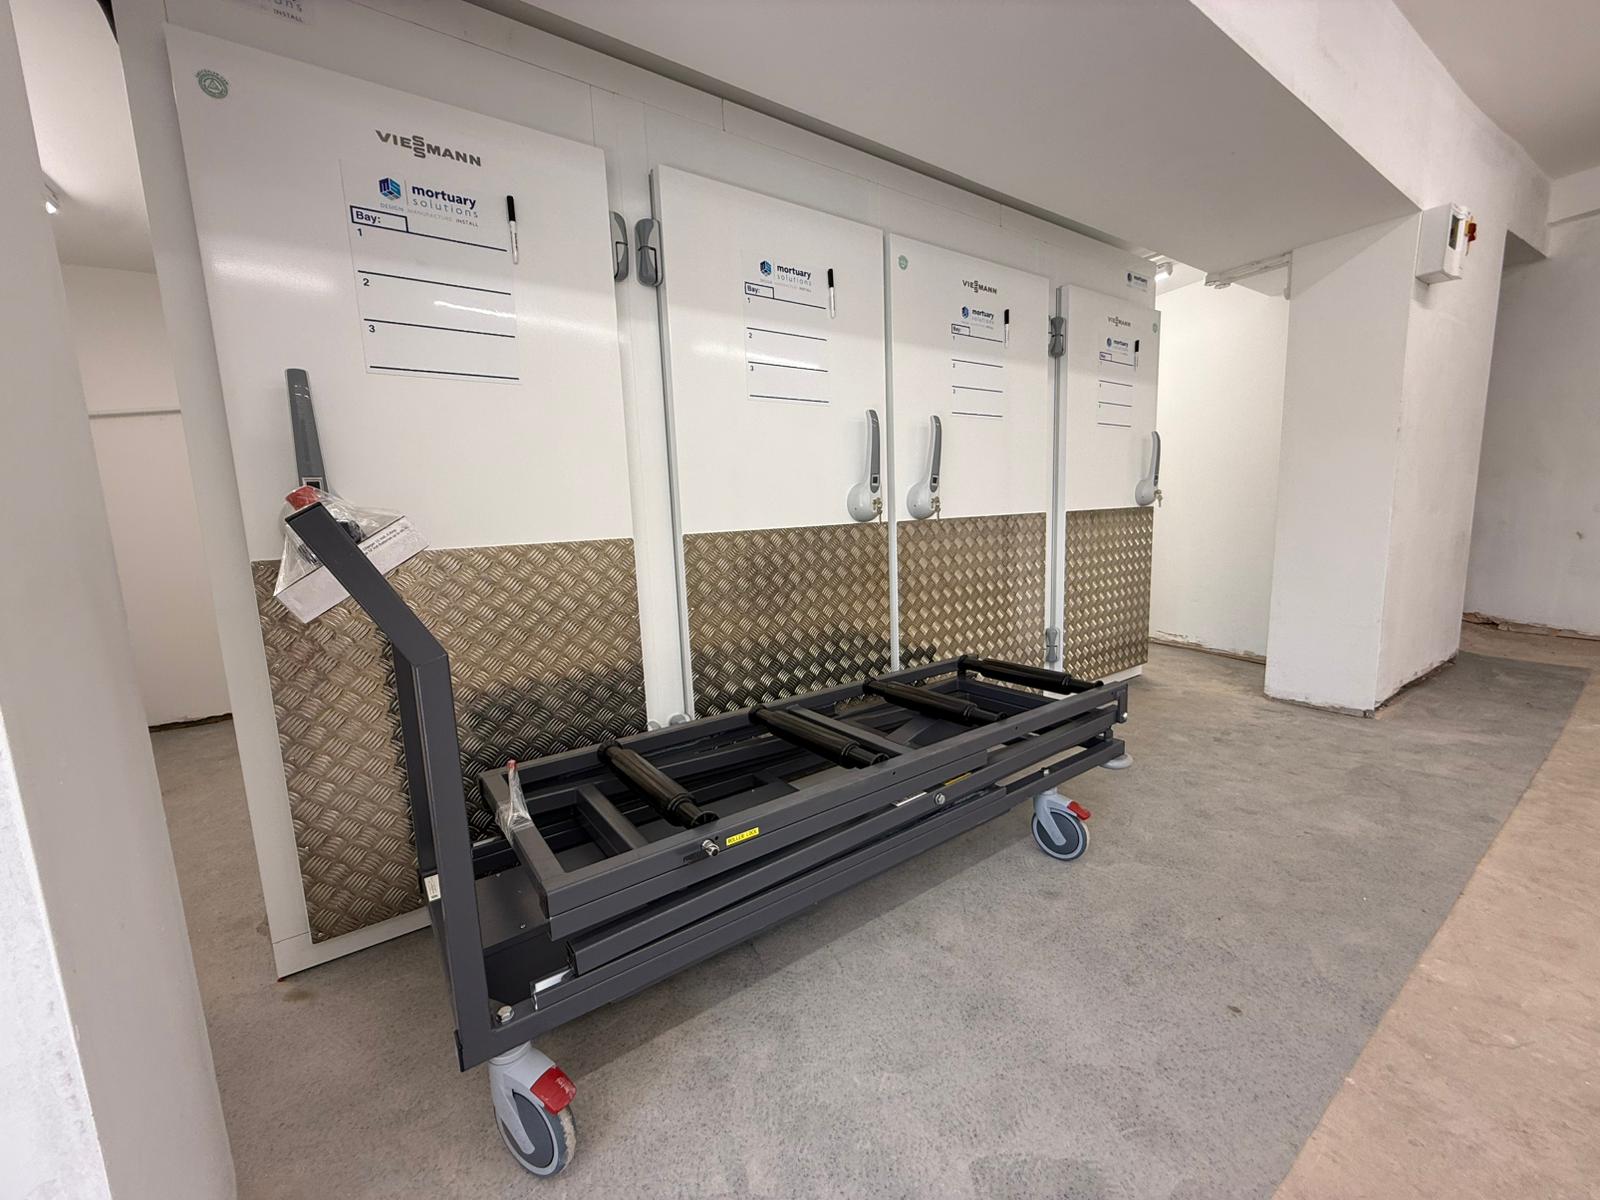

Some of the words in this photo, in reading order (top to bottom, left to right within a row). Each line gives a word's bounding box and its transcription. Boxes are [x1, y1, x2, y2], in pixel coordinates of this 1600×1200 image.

[273, 8, 303, 23] INSTALL
[375, 129, 482, 167] VIESSMANN
[411, 185, 477, 210] mortuary
[412, 197, 479, 219] solutions
[355, 210, 381, 224] Bay:
[455, 218, 479, 228] INSTALL
[357, 228, 363, 237] 1
[776, 265, 811, 280] mortuary
[362, 278, 370, 287] 2
[777, 274, 811, 286] solutions
[962, 280, 997, 294] VIESSMANN
[972, 309, 994, 320] mortuary
[368, 324, 376, 333] 3
